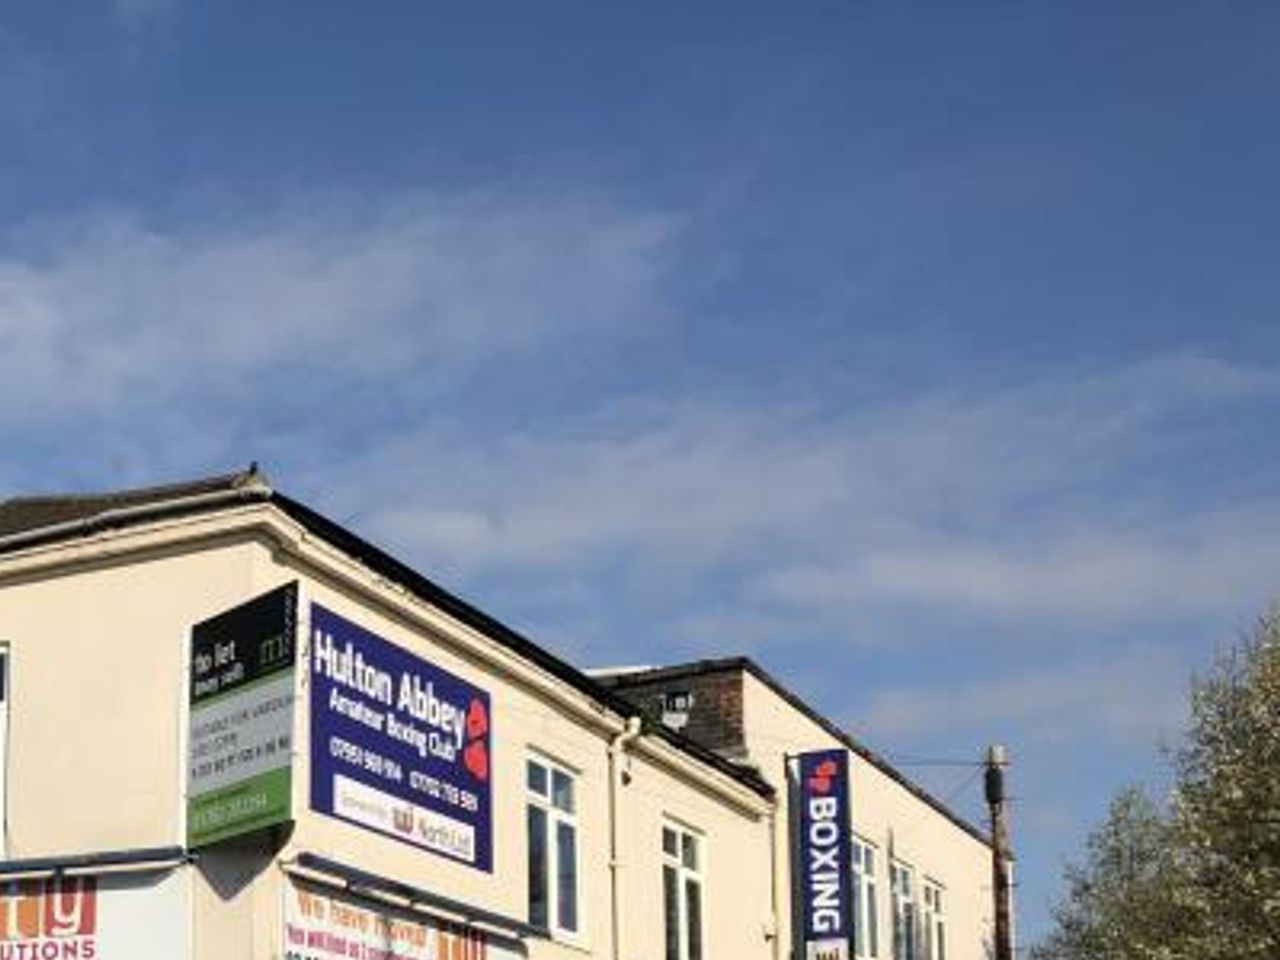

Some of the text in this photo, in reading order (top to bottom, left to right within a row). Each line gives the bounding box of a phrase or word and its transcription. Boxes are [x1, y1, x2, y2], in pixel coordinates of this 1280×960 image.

[315, 630, 466, 750] Hulton Abbey
[387, 712, 427, 757] Boxing
[429, 732, 456, 763] Club
[807, 797, 842, 933] BOXING
